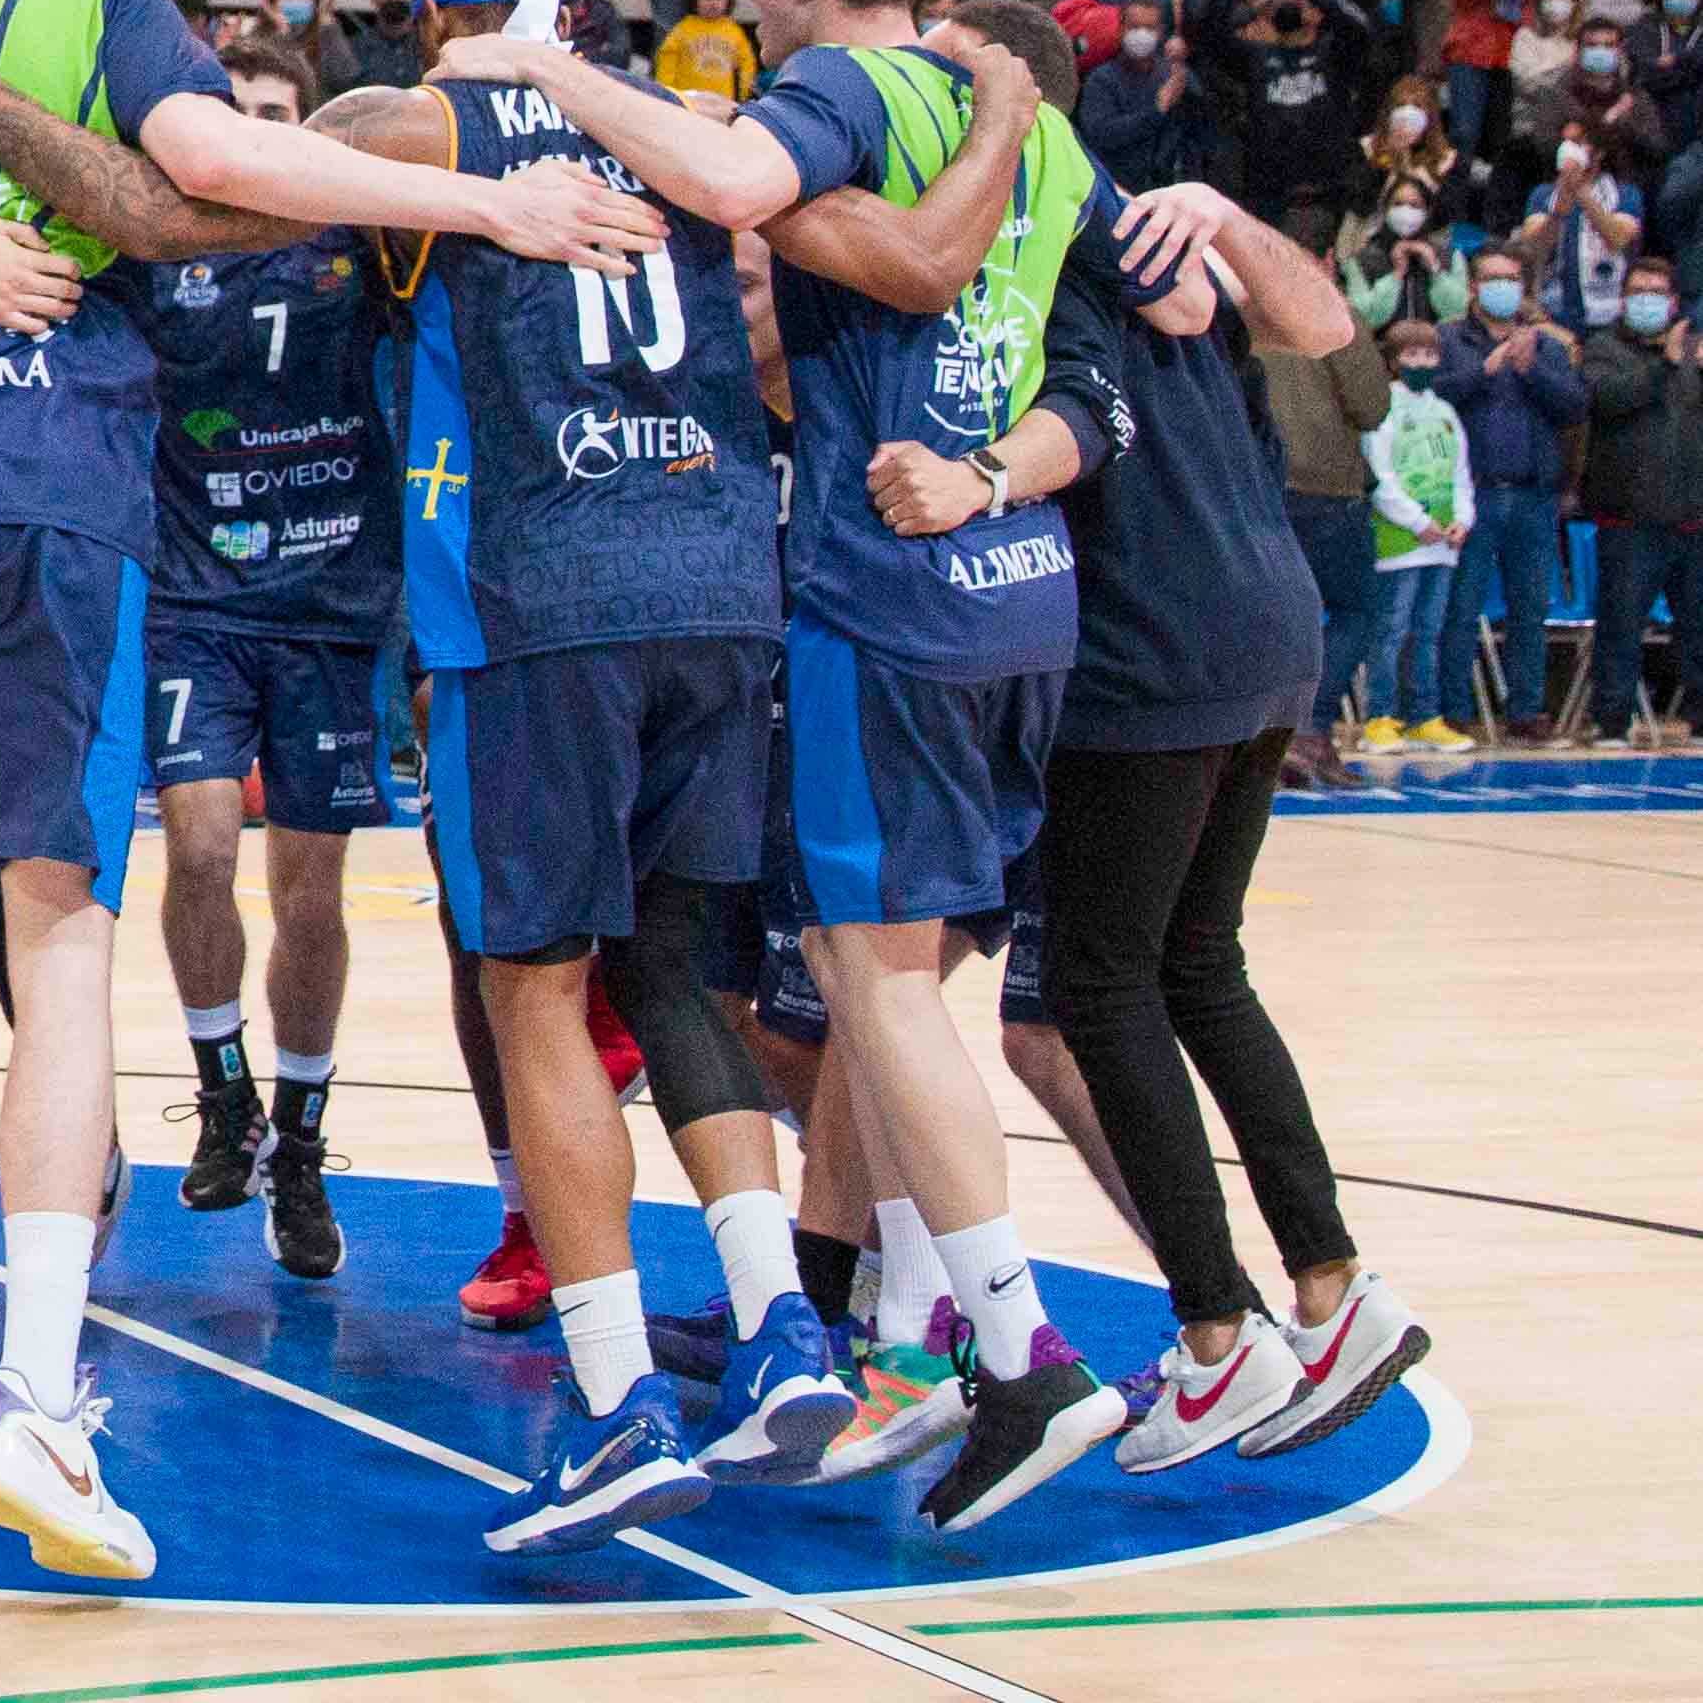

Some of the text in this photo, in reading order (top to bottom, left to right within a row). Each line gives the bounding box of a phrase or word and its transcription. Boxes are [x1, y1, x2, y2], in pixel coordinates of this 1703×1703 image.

[252, 303, 288, 372] 7
[240, 422, 320, 447] Unicaja
[244, 457, 355, 495] OVIEDO
[280, 512, 361, 542] Asturia
[159, 678, 193, 745] 7
